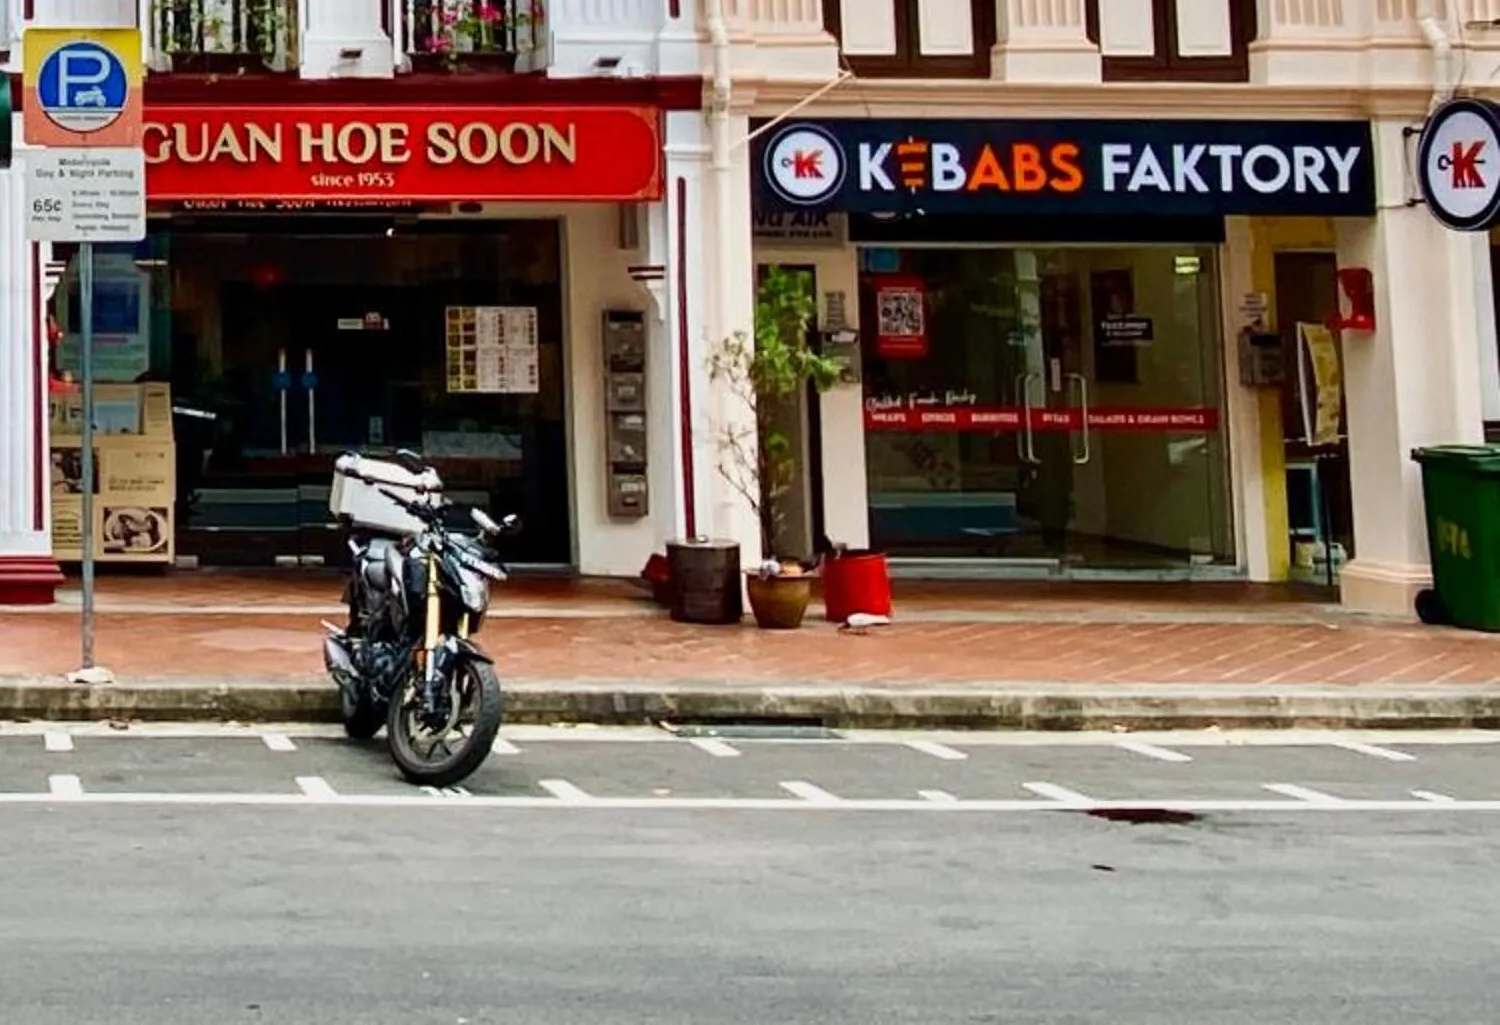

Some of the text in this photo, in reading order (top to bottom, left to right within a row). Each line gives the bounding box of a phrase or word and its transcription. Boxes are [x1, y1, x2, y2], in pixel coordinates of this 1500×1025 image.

[143, 122, 577, 165] GUAN HOE SOON
[858, 136, 1361, 194] KEBABS FAKTORY
[311, 172, 353, 187] since
